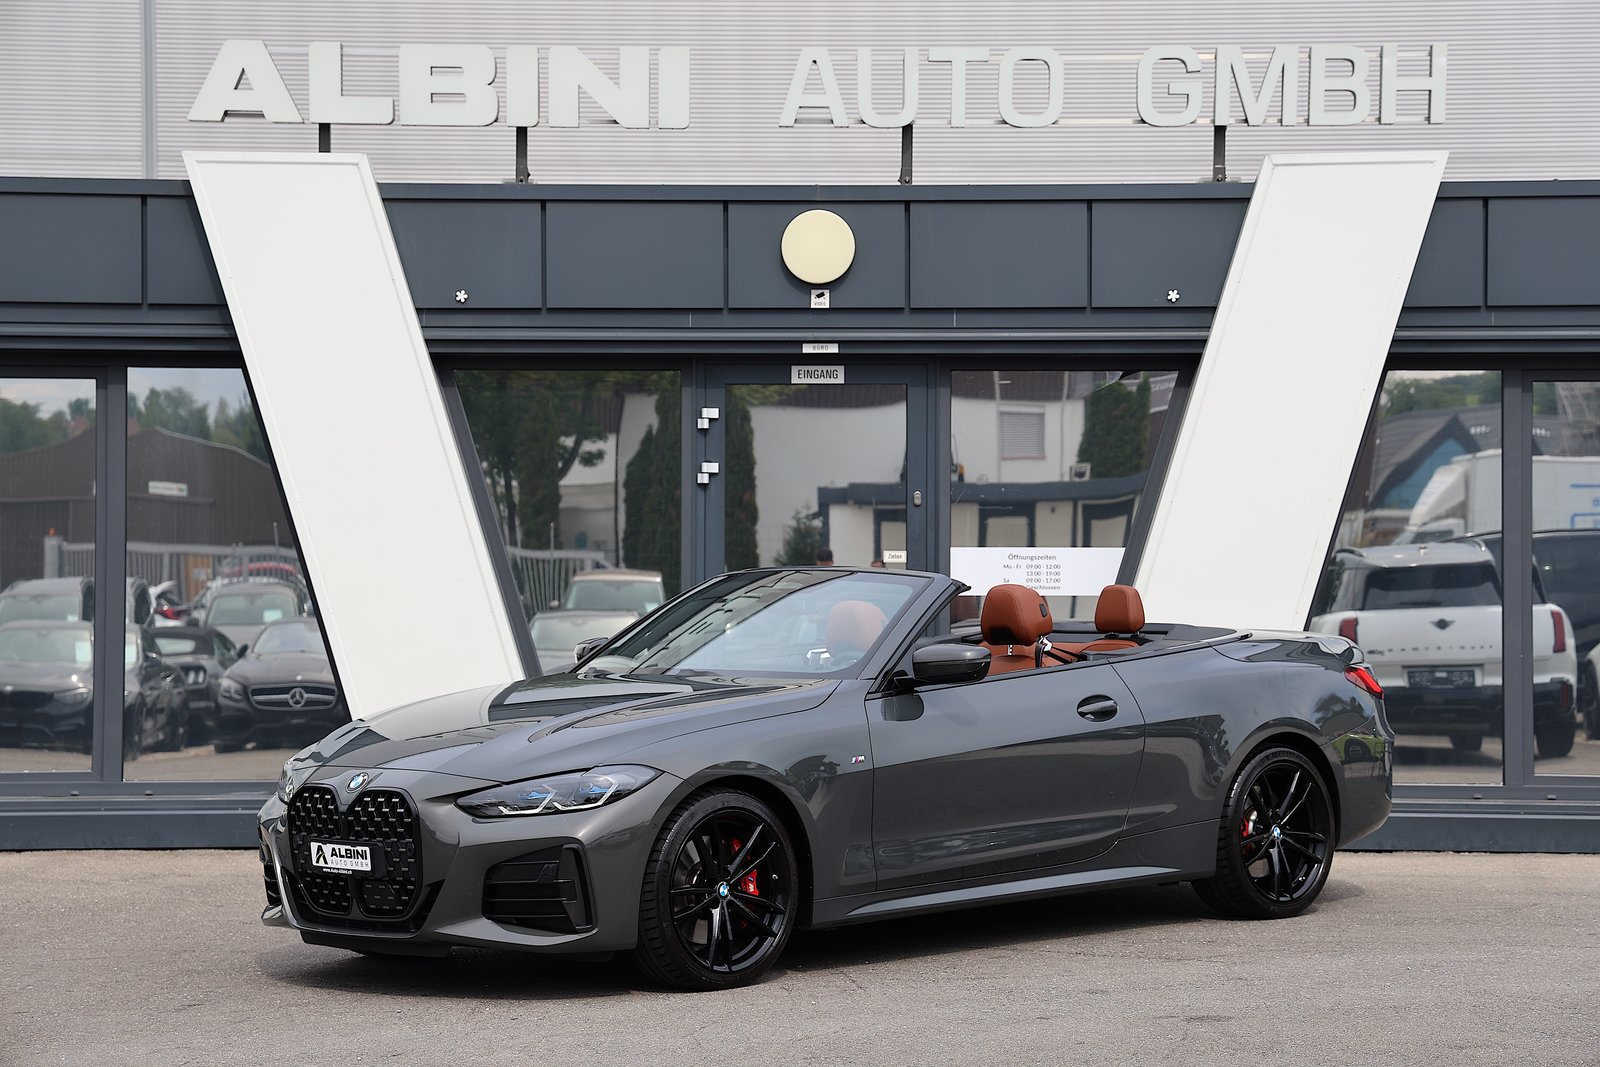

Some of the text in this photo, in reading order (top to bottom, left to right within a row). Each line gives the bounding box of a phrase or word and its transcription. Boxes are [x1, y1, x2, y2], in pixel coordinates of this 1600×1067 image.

[188, 39, 1449, 130] ALBINI AUTO GMBH
[797, 369, 839, 379] EINGANG
[1008, 553, 1057, 561] Öffnungszeiten
[330, 847, 368, 860] ALBINI
[350, 860, 369, 868] GMBH
